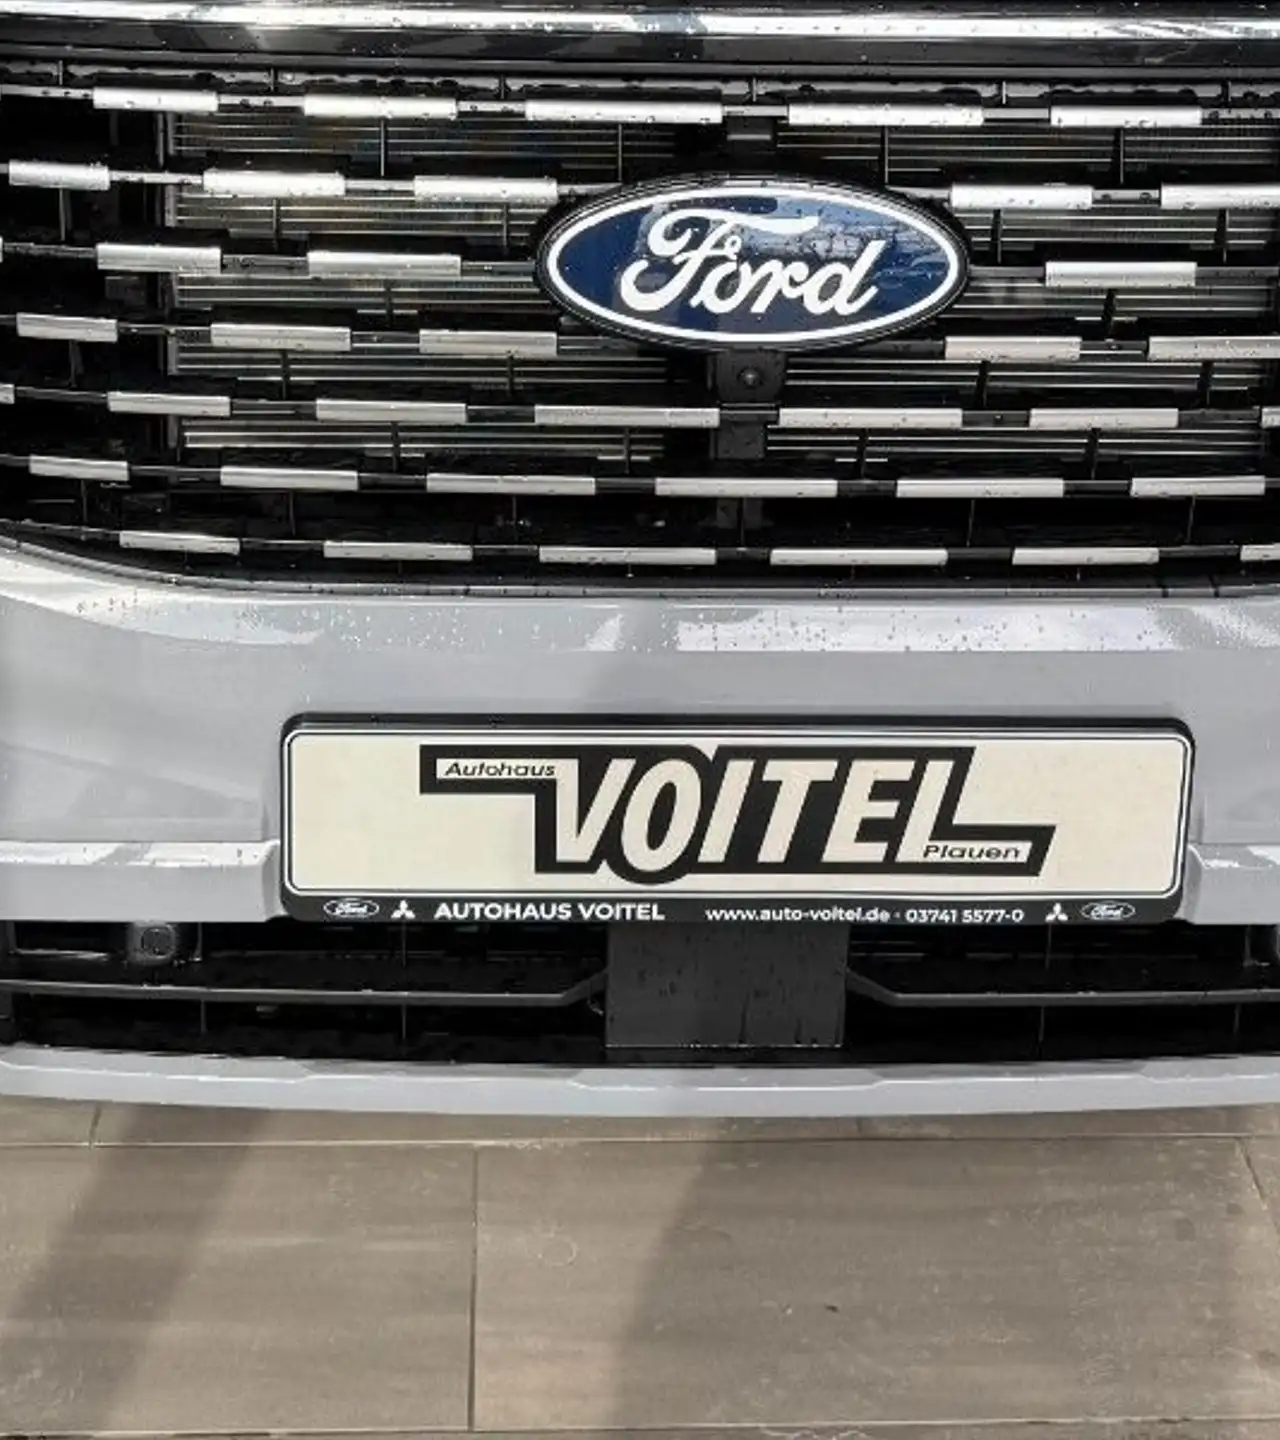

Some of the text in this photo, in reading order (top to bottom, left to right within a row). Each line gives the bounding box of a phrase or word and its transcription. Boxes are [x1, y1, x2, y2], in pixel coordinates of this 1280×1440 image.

[620, 207, 886, 316] Ford
[444, 762, 556, 777] Autohaus
[554, 757, 960, 873] VOITEL
[922, 844, 1022, 861] Plauen
[433, 901, 666, 922] AUTOHAUS VOITEL
[704, 905, 1025, 924] www.auto-voitel.de 03741 5577-0
